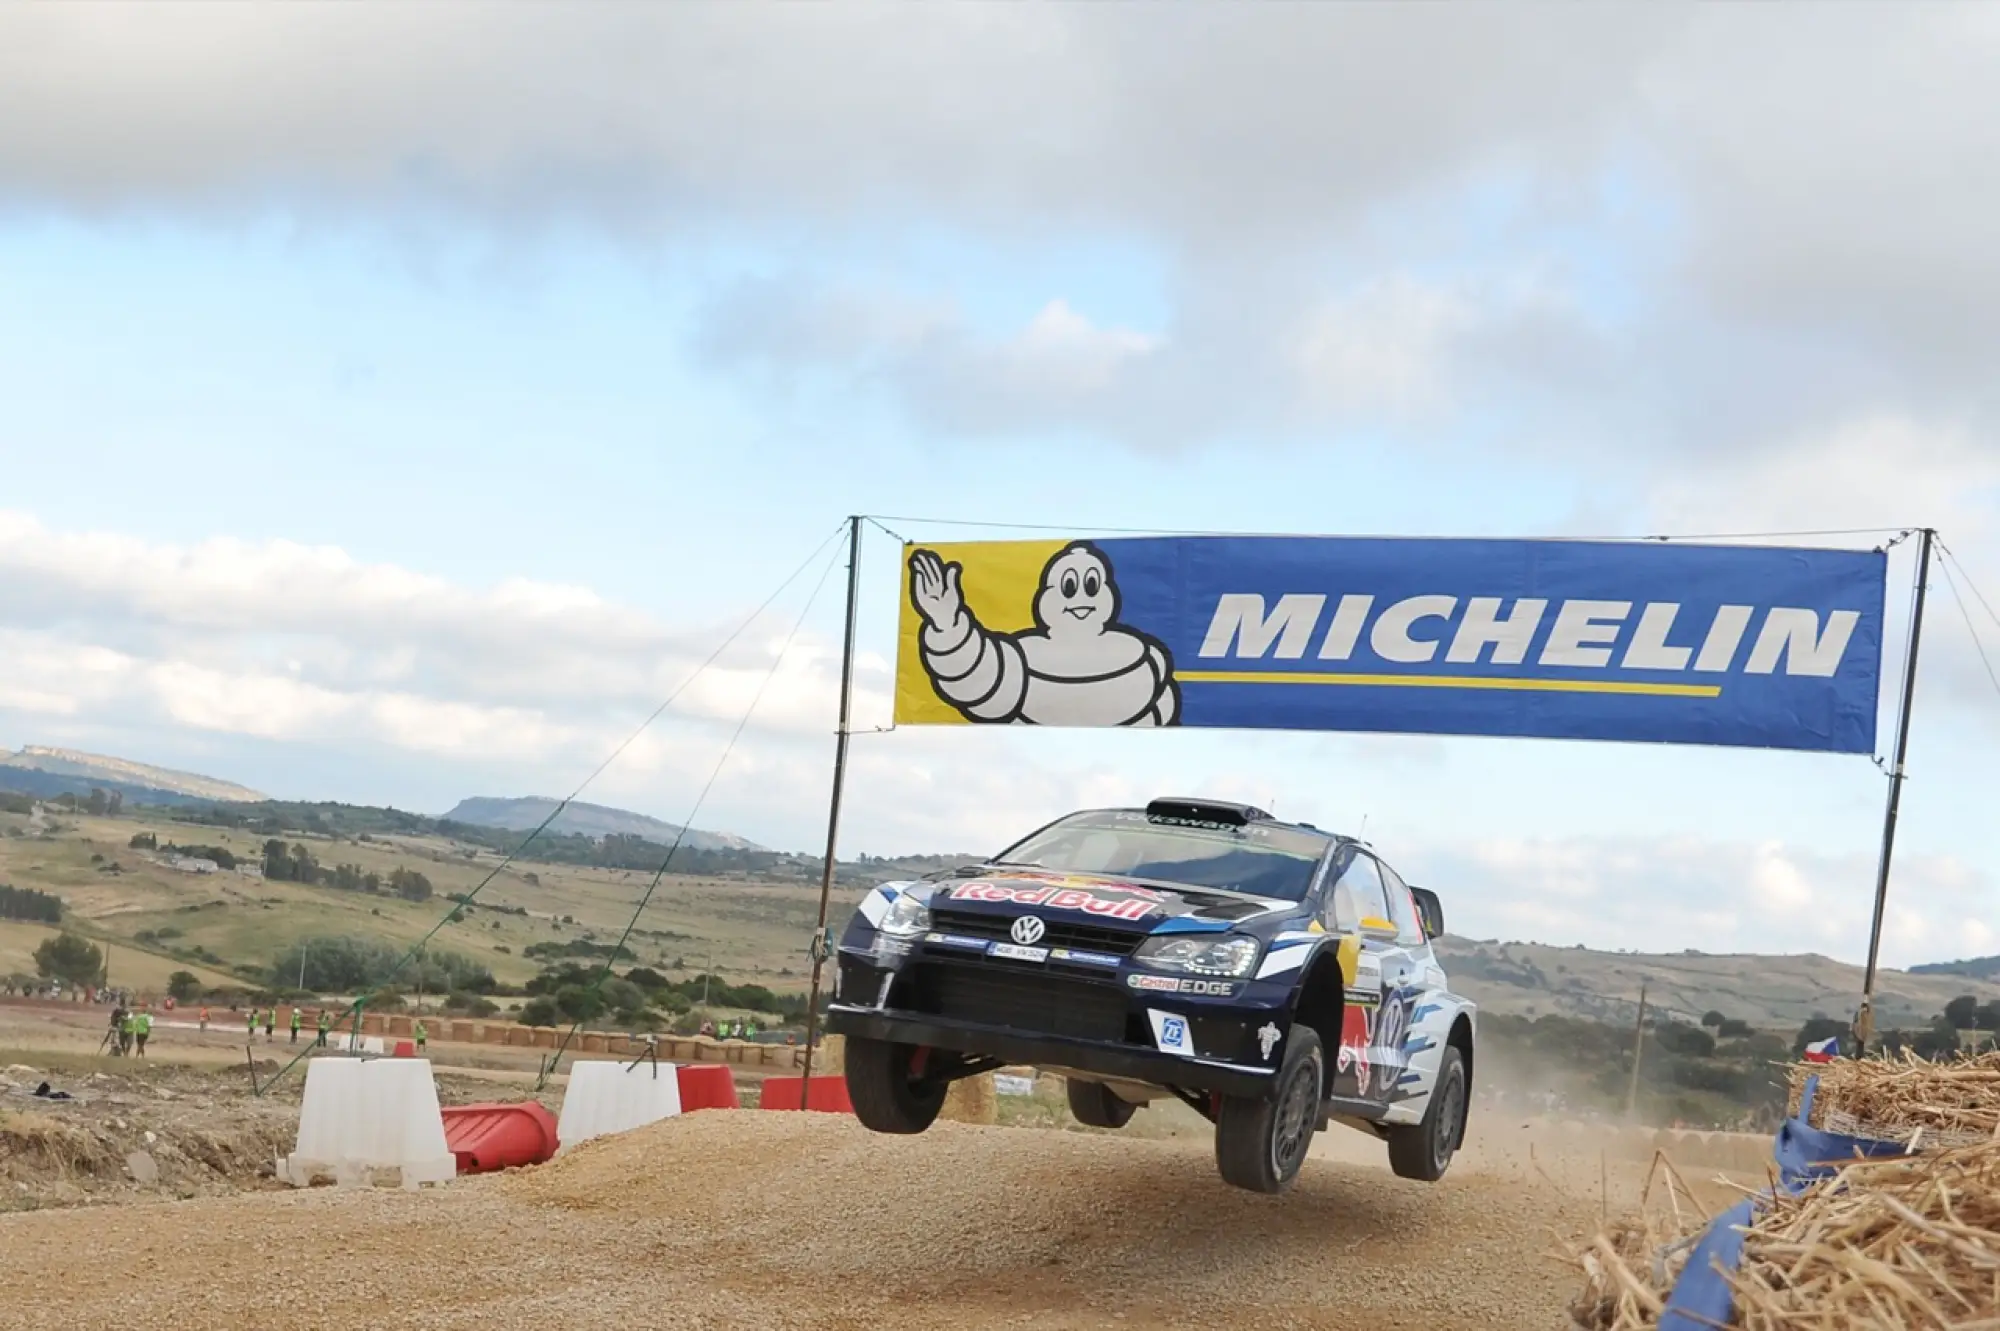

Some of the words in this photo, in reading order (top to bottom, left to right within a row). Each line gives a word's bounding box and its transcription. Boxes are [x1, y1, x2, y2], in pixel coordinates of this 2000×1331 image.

[1198, 593, 1860, 678] MICHELIN
[950, 882, 1047, 904] Red
[1047, 890, 1158, 920] Bull
[1139, 976, 1178, 990] Castrol
[1179, 979, 1233, 995] EDGE
